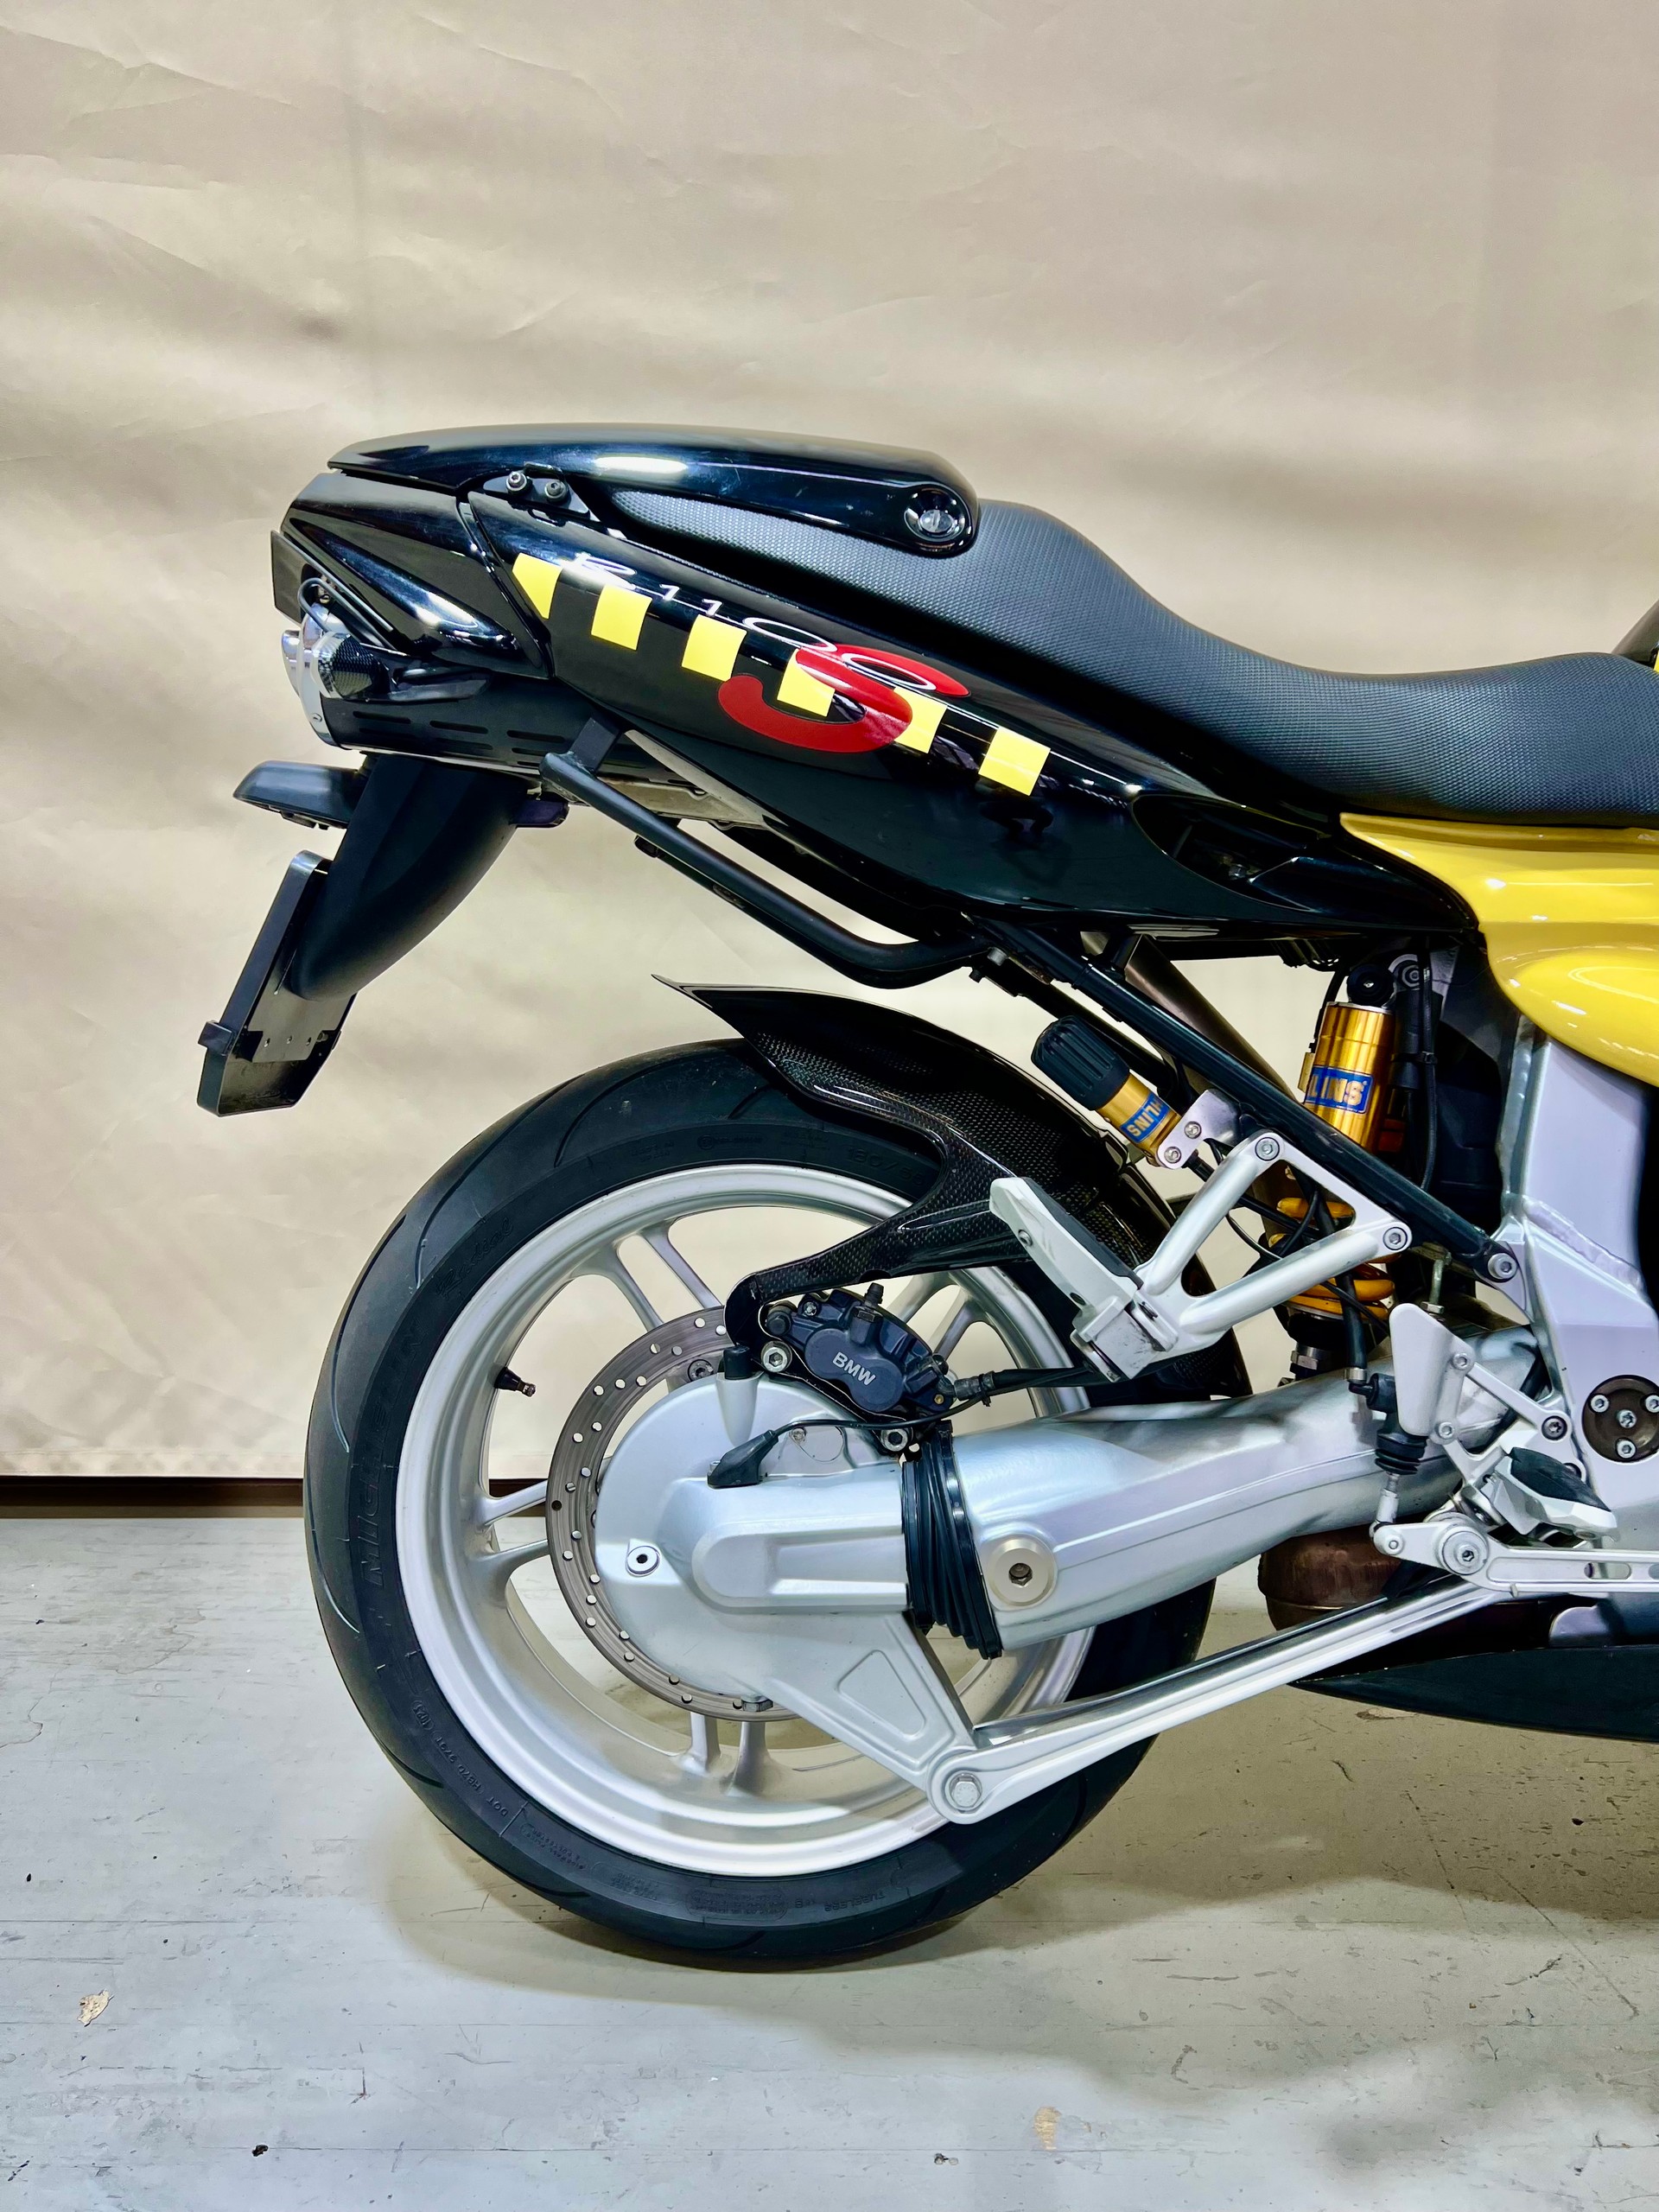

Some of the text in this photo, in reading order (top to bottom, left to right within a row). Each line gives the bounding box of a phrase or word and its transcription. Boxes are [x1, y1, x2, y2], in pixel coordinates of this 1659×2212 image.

[1307, 1074, 1365, 1106] LINS
[1127, 1097, 1163, 1137] HLINS
[832, 1351, 876, 1386] BMW
